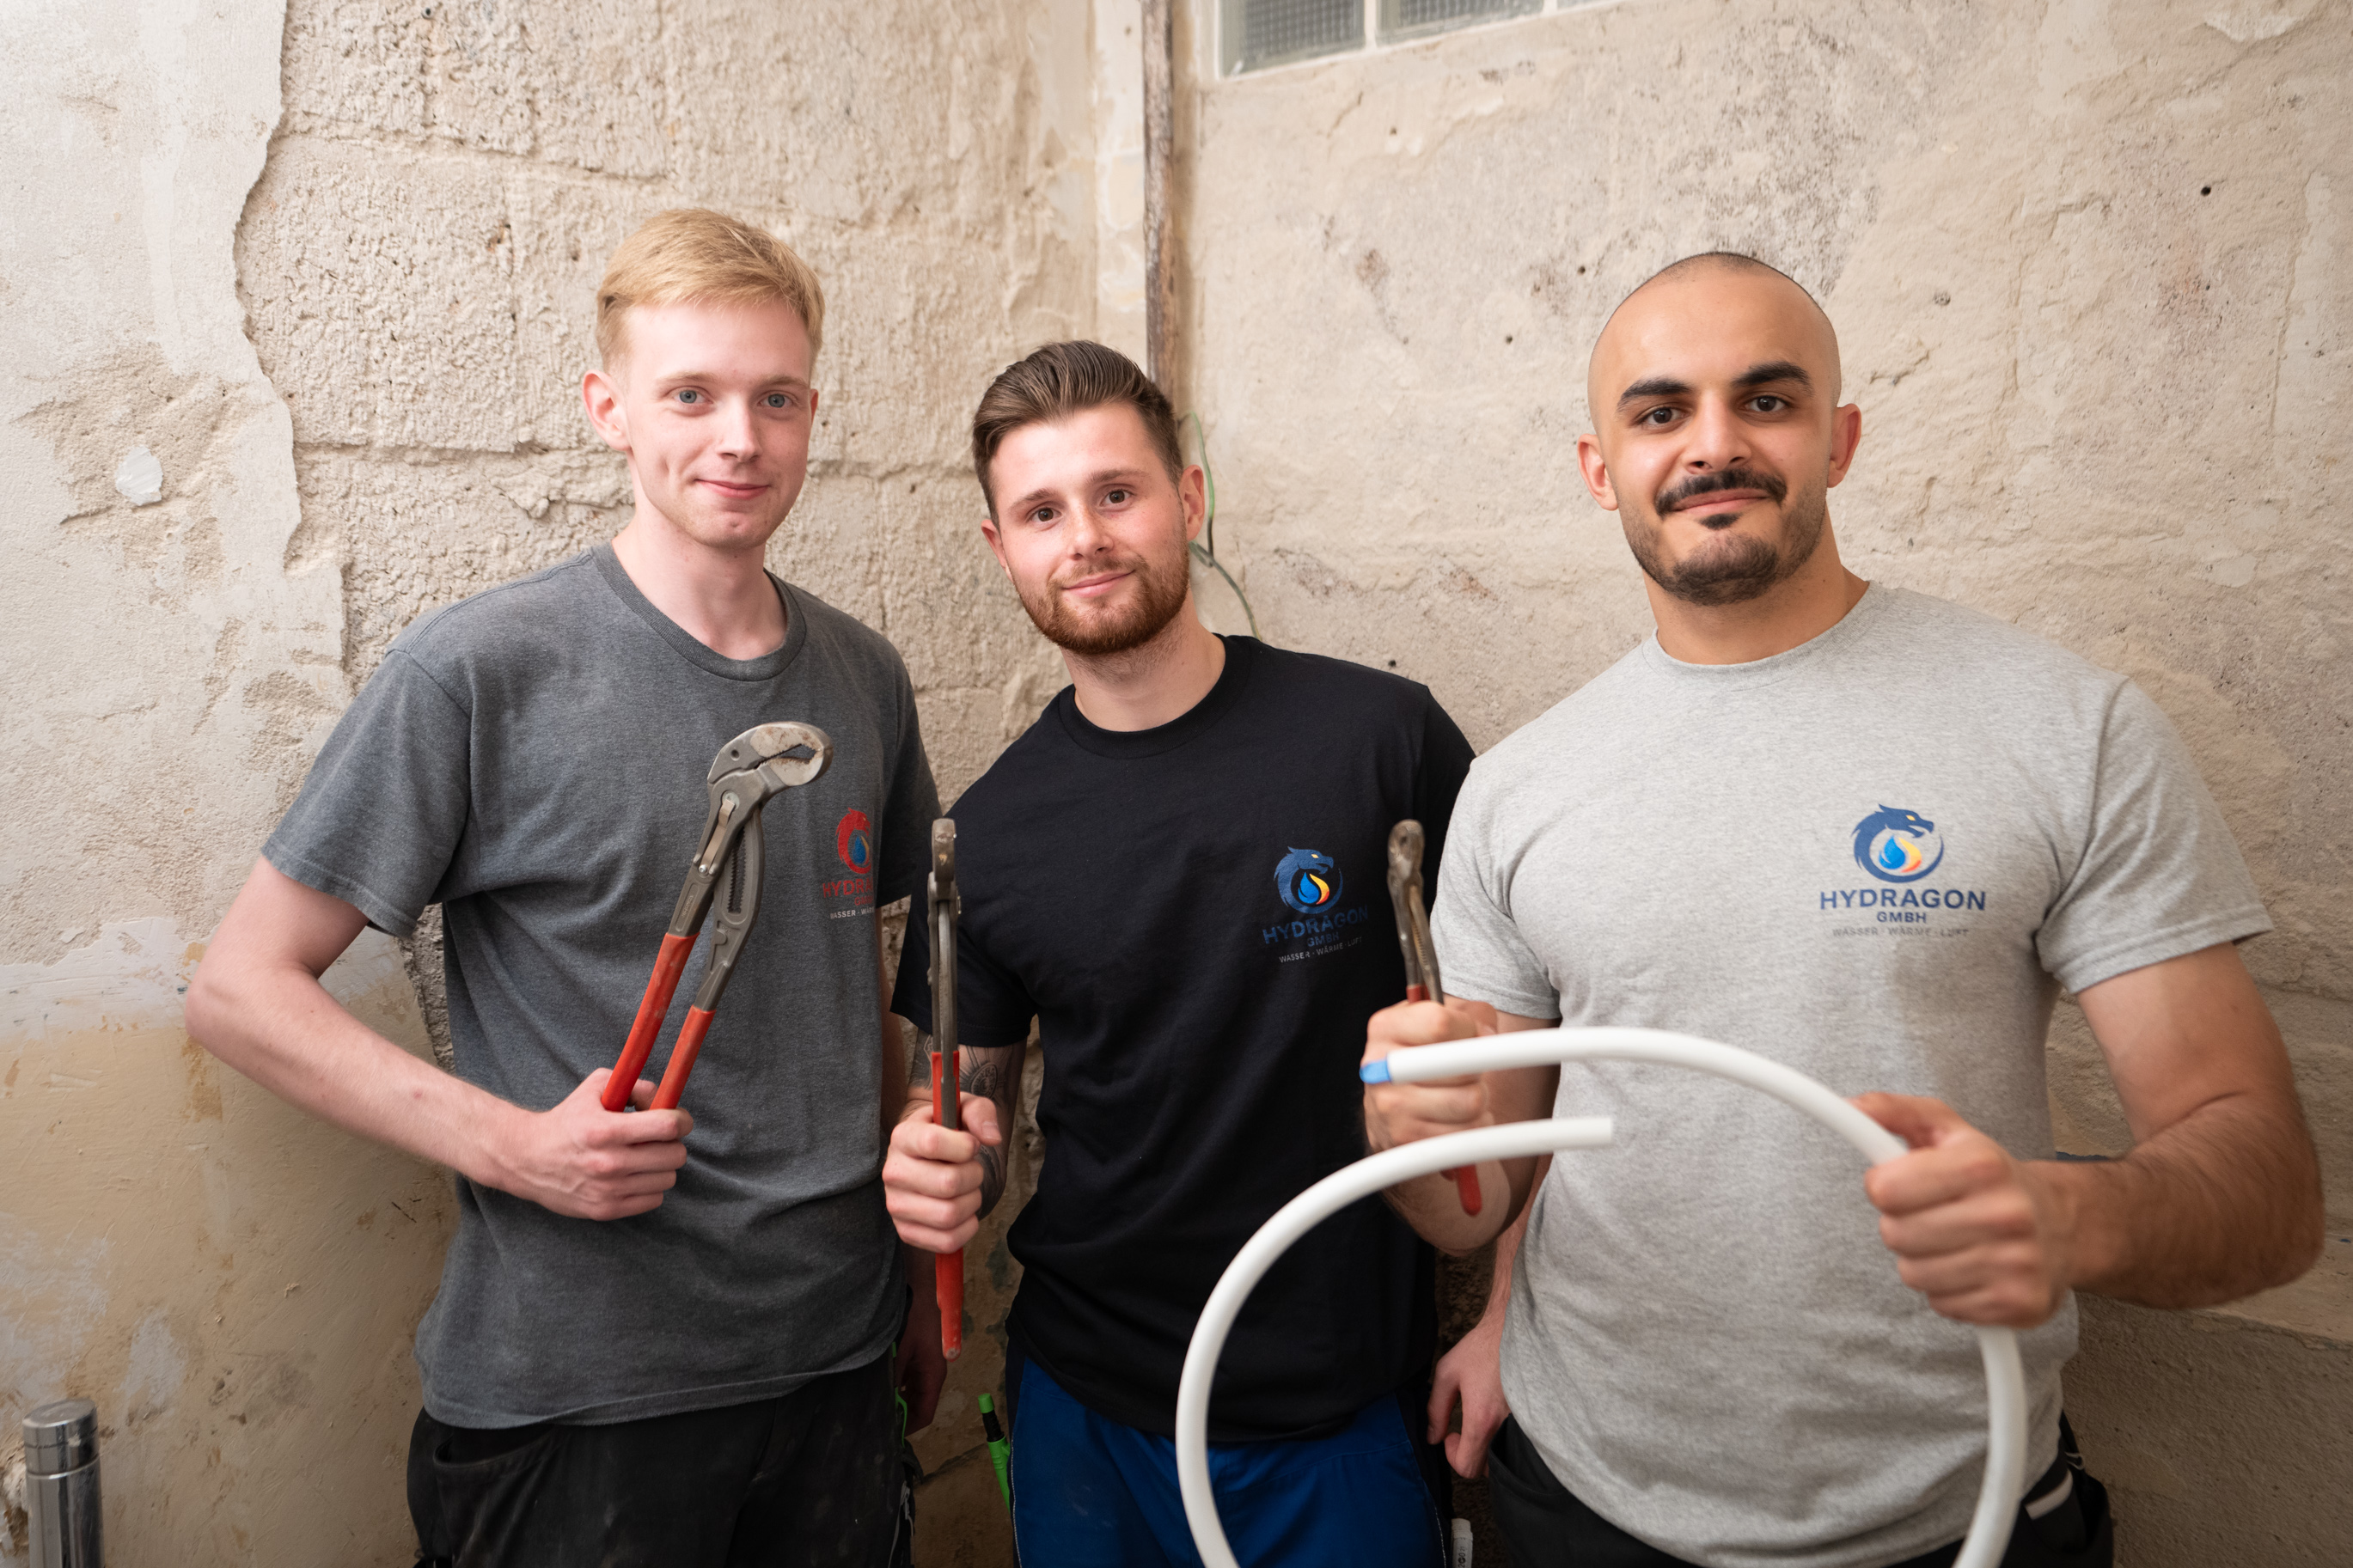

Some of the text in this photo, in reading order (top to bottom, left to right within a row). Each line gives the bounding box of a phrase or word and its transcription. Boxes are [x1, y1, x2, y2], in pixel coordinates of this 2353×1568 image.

[1820, 888, 1986, 911] HYDRAGON
[1262, 905, 1368, 944] HYDRAGON
[1876, 911, 1927, 924] GMBH
[1832, 926, 1879, 937] WASSER
[1306, 931, 1340, 947] GMBH
[1278, 951, 1311, 963] WASSER
